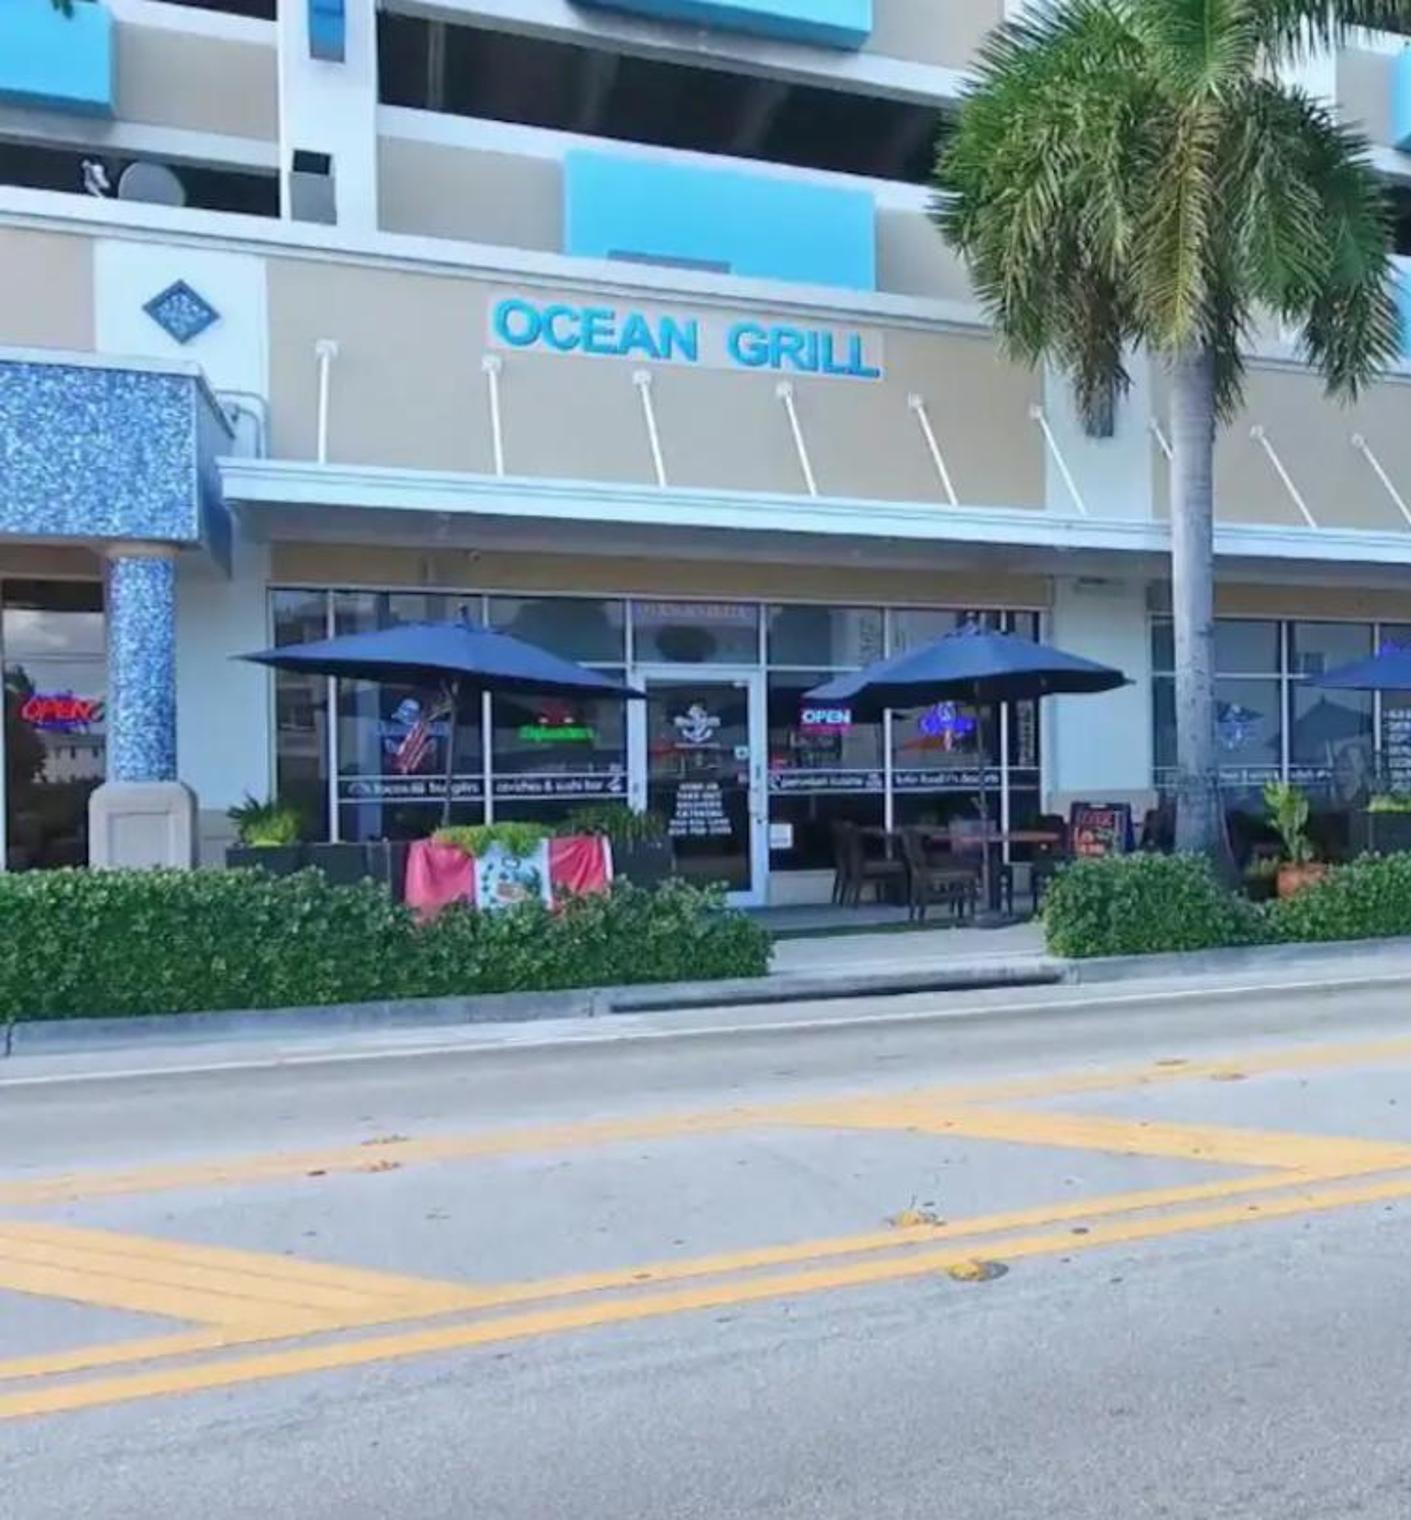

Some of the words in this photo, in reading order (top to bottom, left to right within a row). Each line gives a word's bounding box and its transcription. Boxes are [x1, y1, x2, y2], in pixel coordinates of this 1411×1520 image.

[494, 297, 698, 361] OCEAN
[728, 322, 880, 379] GRILL
[21, 698, 92, 722] OPEN
[801, 708, 851, 724] OPEN
